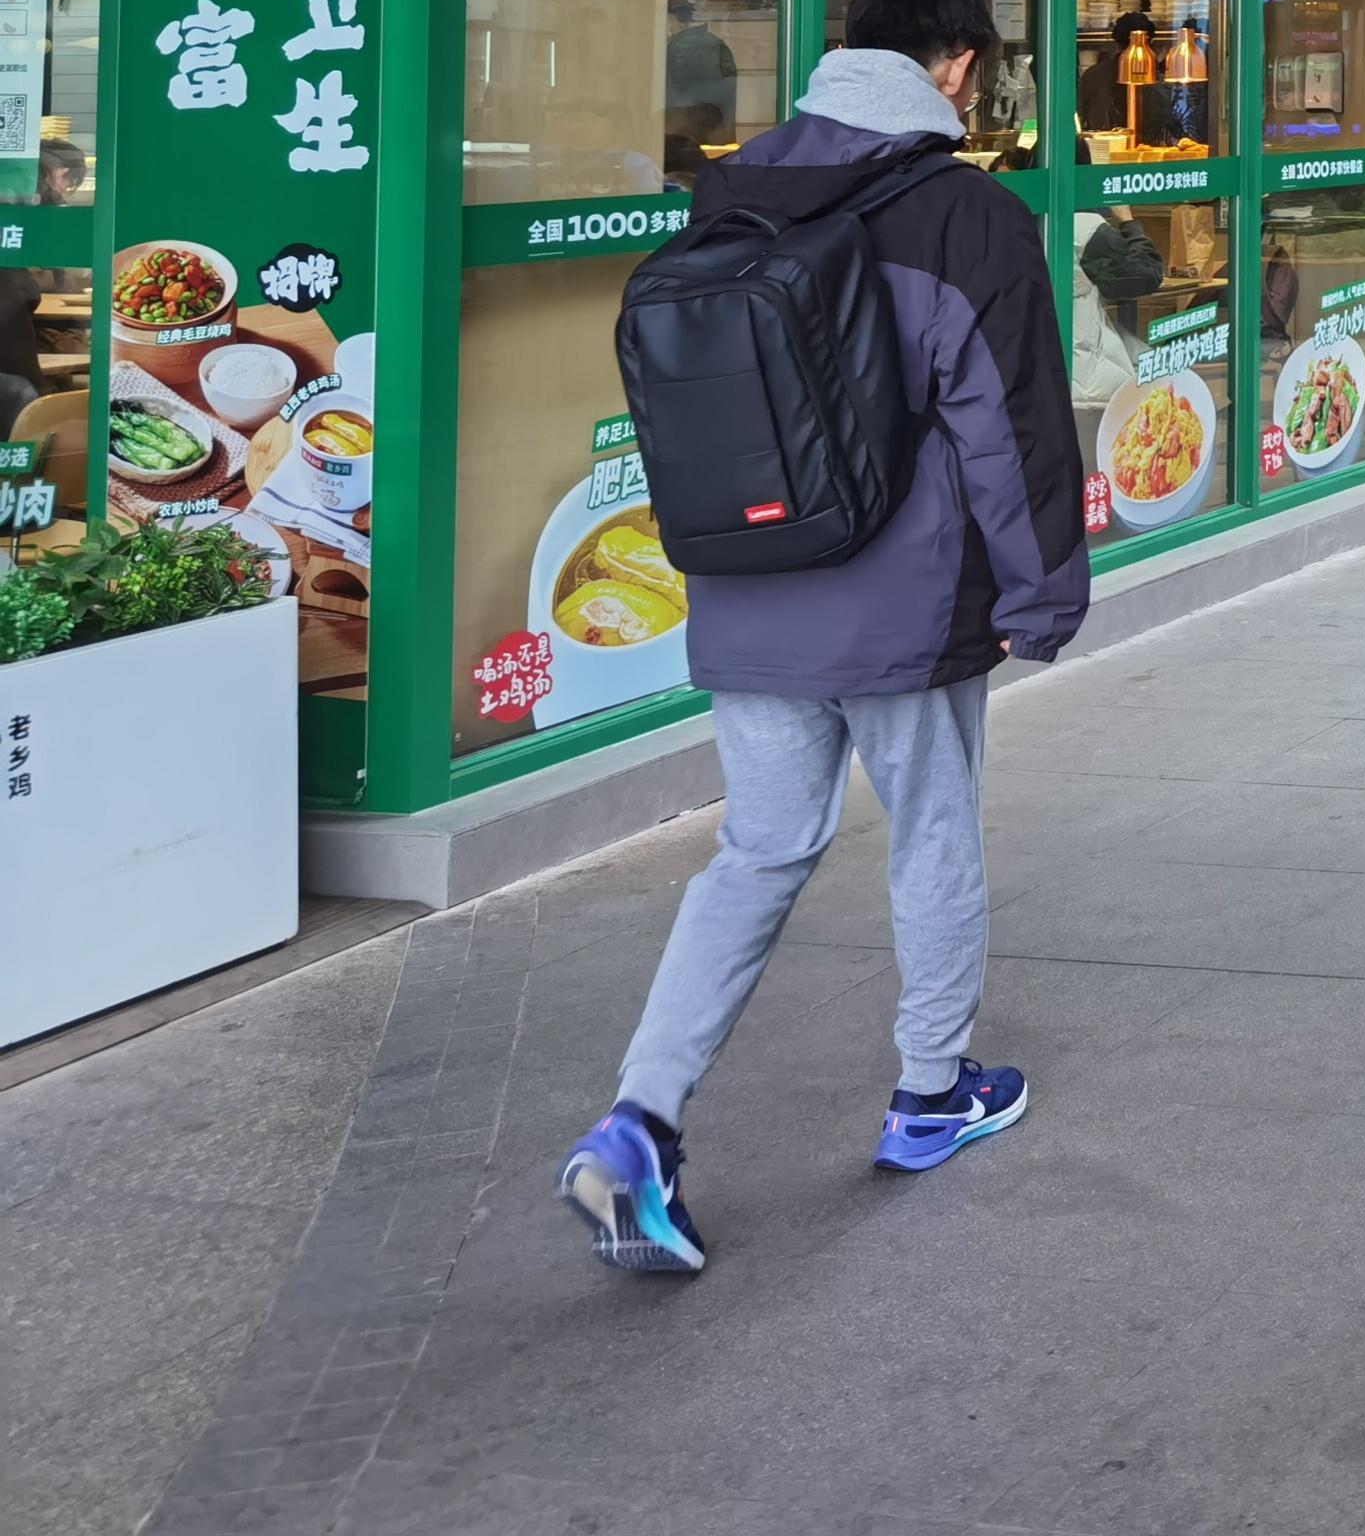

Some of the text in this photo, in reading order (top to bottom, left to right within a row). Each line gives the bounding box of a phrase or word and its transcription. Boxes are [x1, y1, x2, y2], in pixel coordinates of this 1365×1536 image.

[1102, 171, 1208, 195] 全国1000多家快餐店
[1281, 160, 1364, 181] 全国1000多家快餐店
[260, 253, 338, 303] 招牌
[156, 323, 233, 345] 经典毛豆烧鸡
[1137, 323, 1230, 387] 西红柿炒鸡蛋
[280, 373, 342, 421] 肥西老母鸡汤
[159, 497, 219, 517] 农家小炒肉
[474, 635, 551, 683] 喝汤还是
[480, 669, 551, 714] 土鸡汤
[8, 713, 32, 800] 老乡鸡
